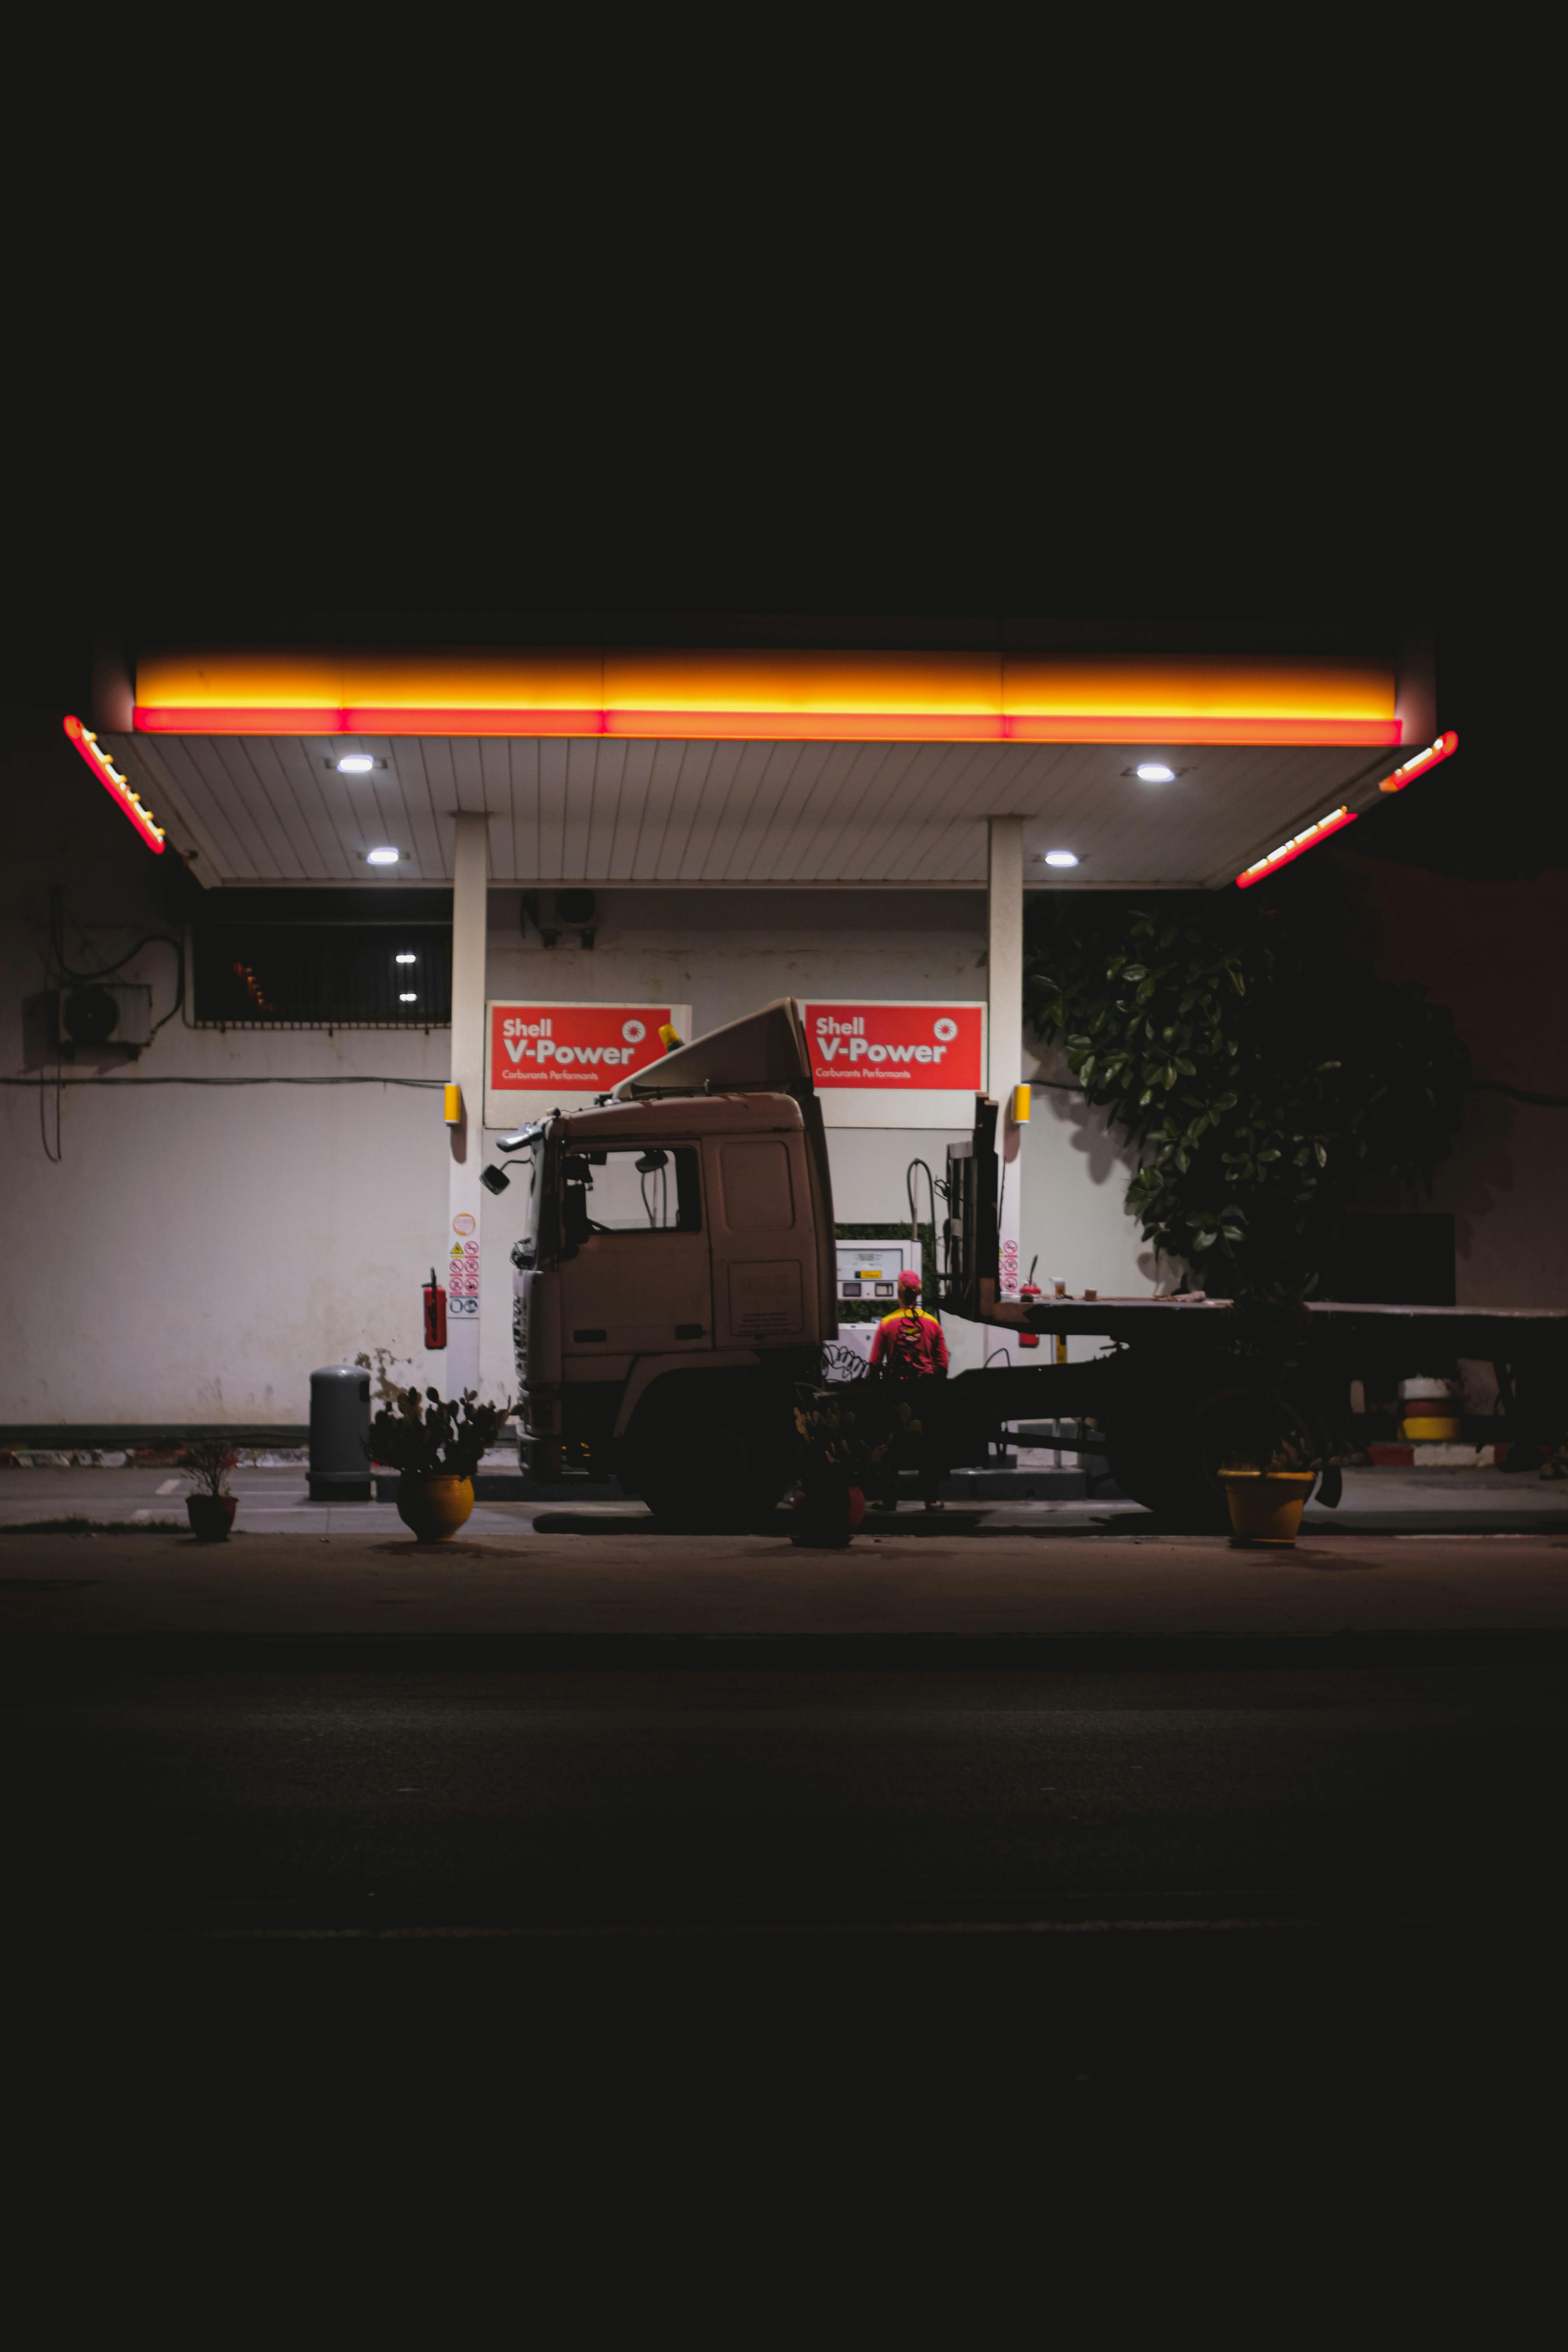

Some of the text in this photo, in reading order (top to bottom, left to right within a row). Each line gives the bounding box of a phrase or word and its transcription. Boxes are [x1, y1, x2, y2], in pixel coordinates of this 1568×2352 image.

[503, 1018, 552, 1037] Shell
[816, 1017, 864, 1035] Shell
[503, 1039, 634, 1065] V-Power
[816, 1037, 946, 1063] V-Power
[502, 1069, 598, 1080] Carburants Performants
[815, 1067, 910, 1079] Carburants Performants
